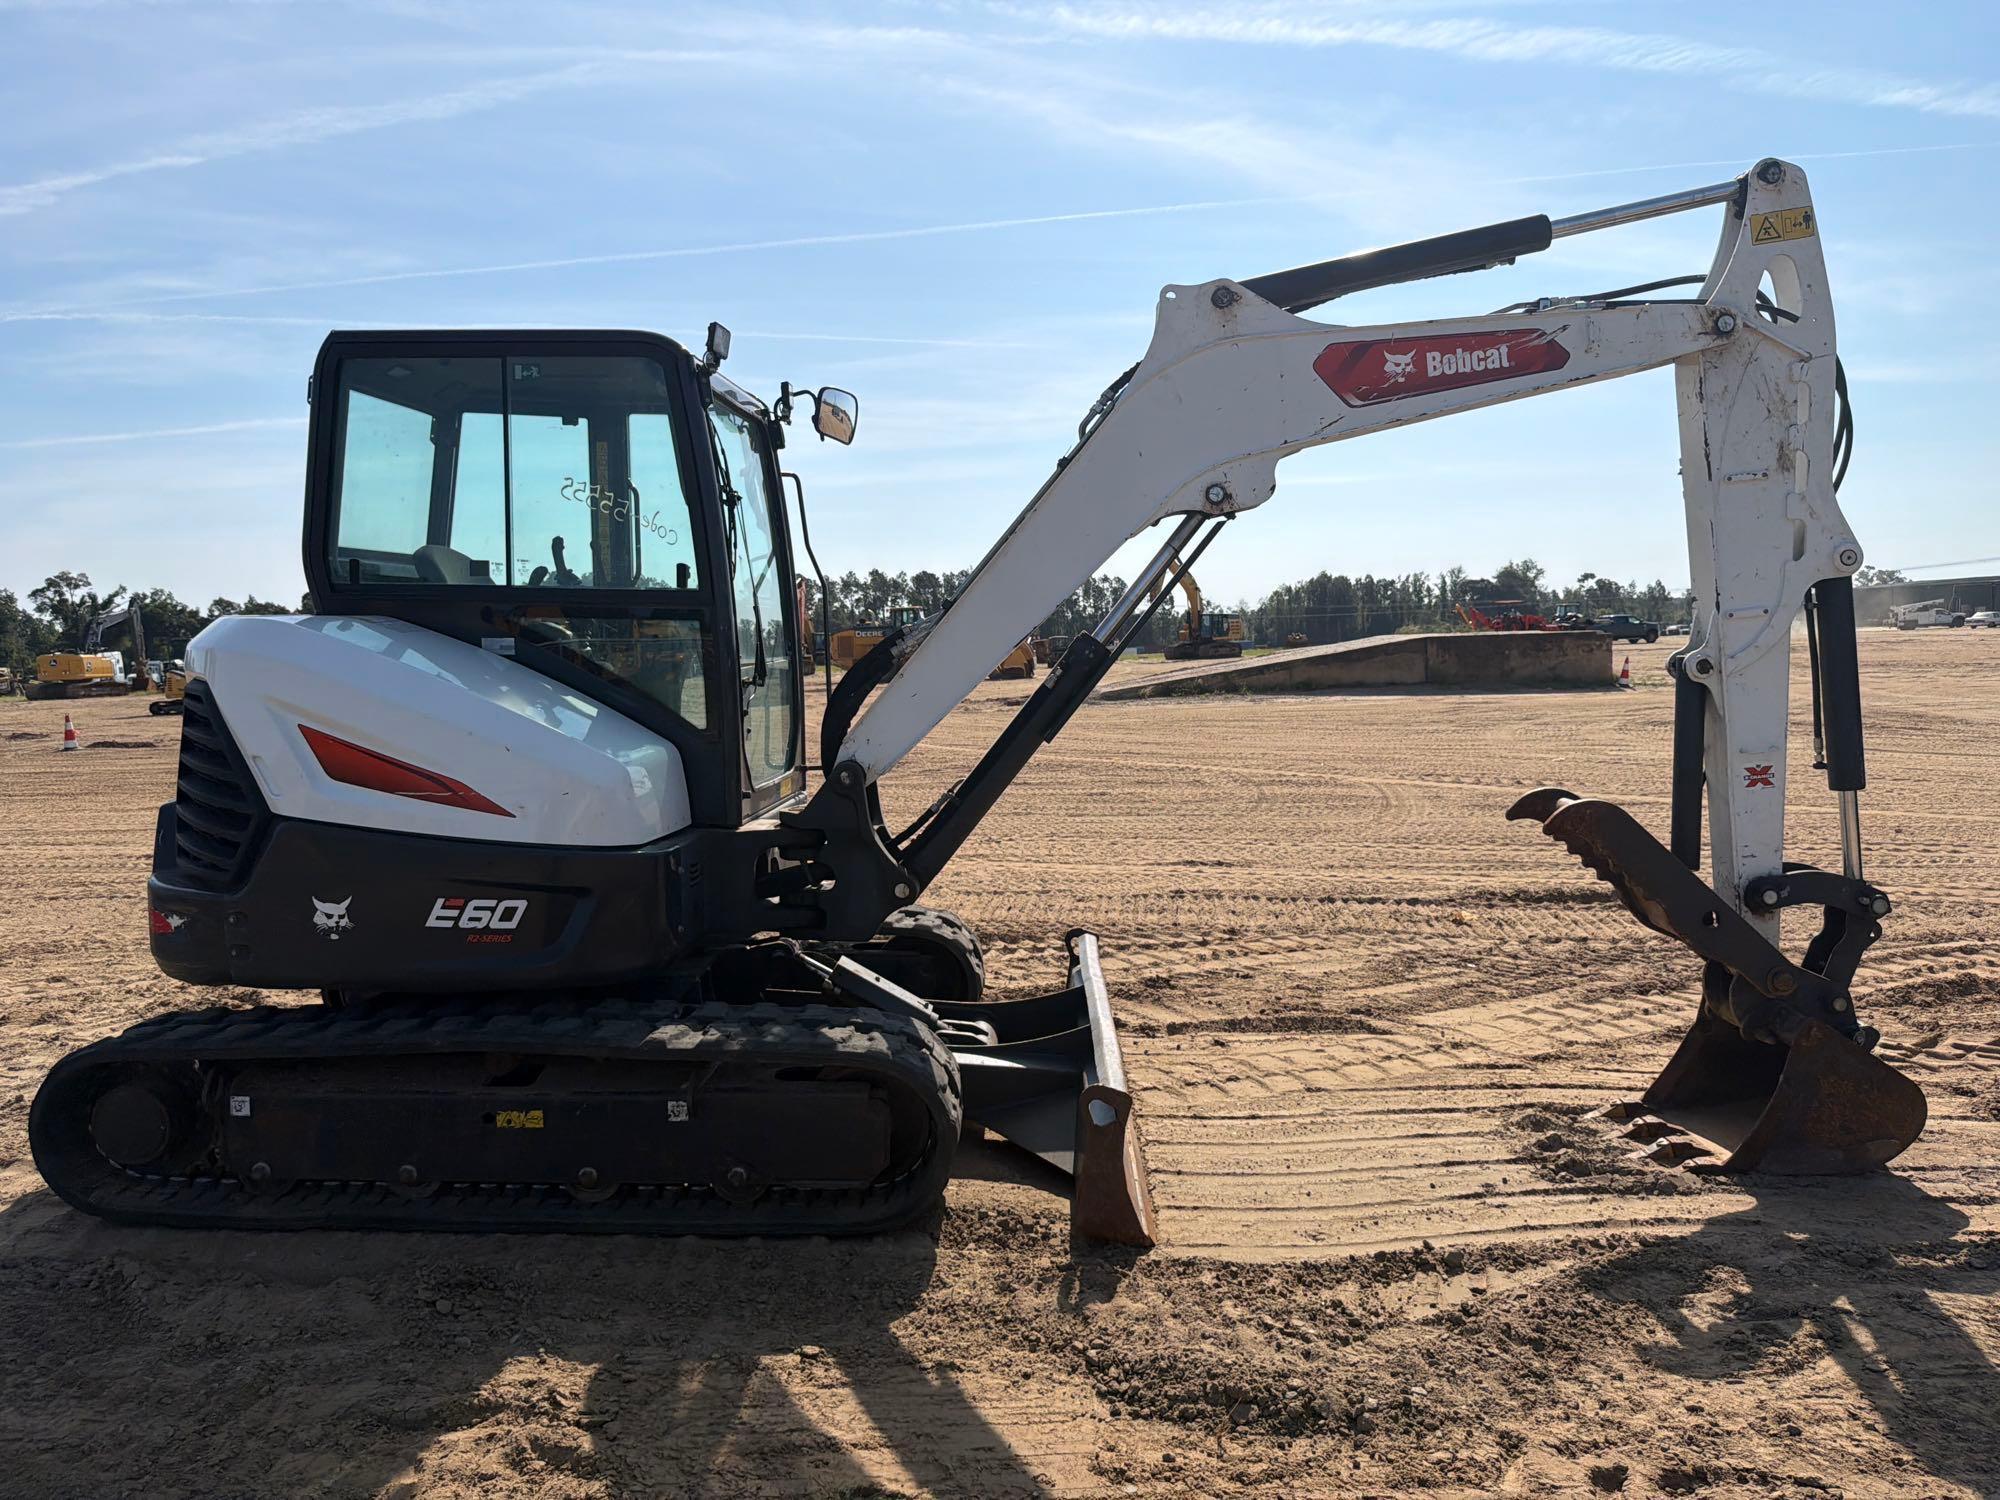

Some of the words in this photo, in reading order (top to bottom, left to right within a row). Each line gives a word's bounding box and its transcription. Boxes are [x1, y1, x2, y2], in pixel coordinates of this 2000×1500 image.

[1426, 345, 1510, 377] Bobcat
[425, 897, 528, 929] E60
[466, 934, 512, 943] R2-SERIES
